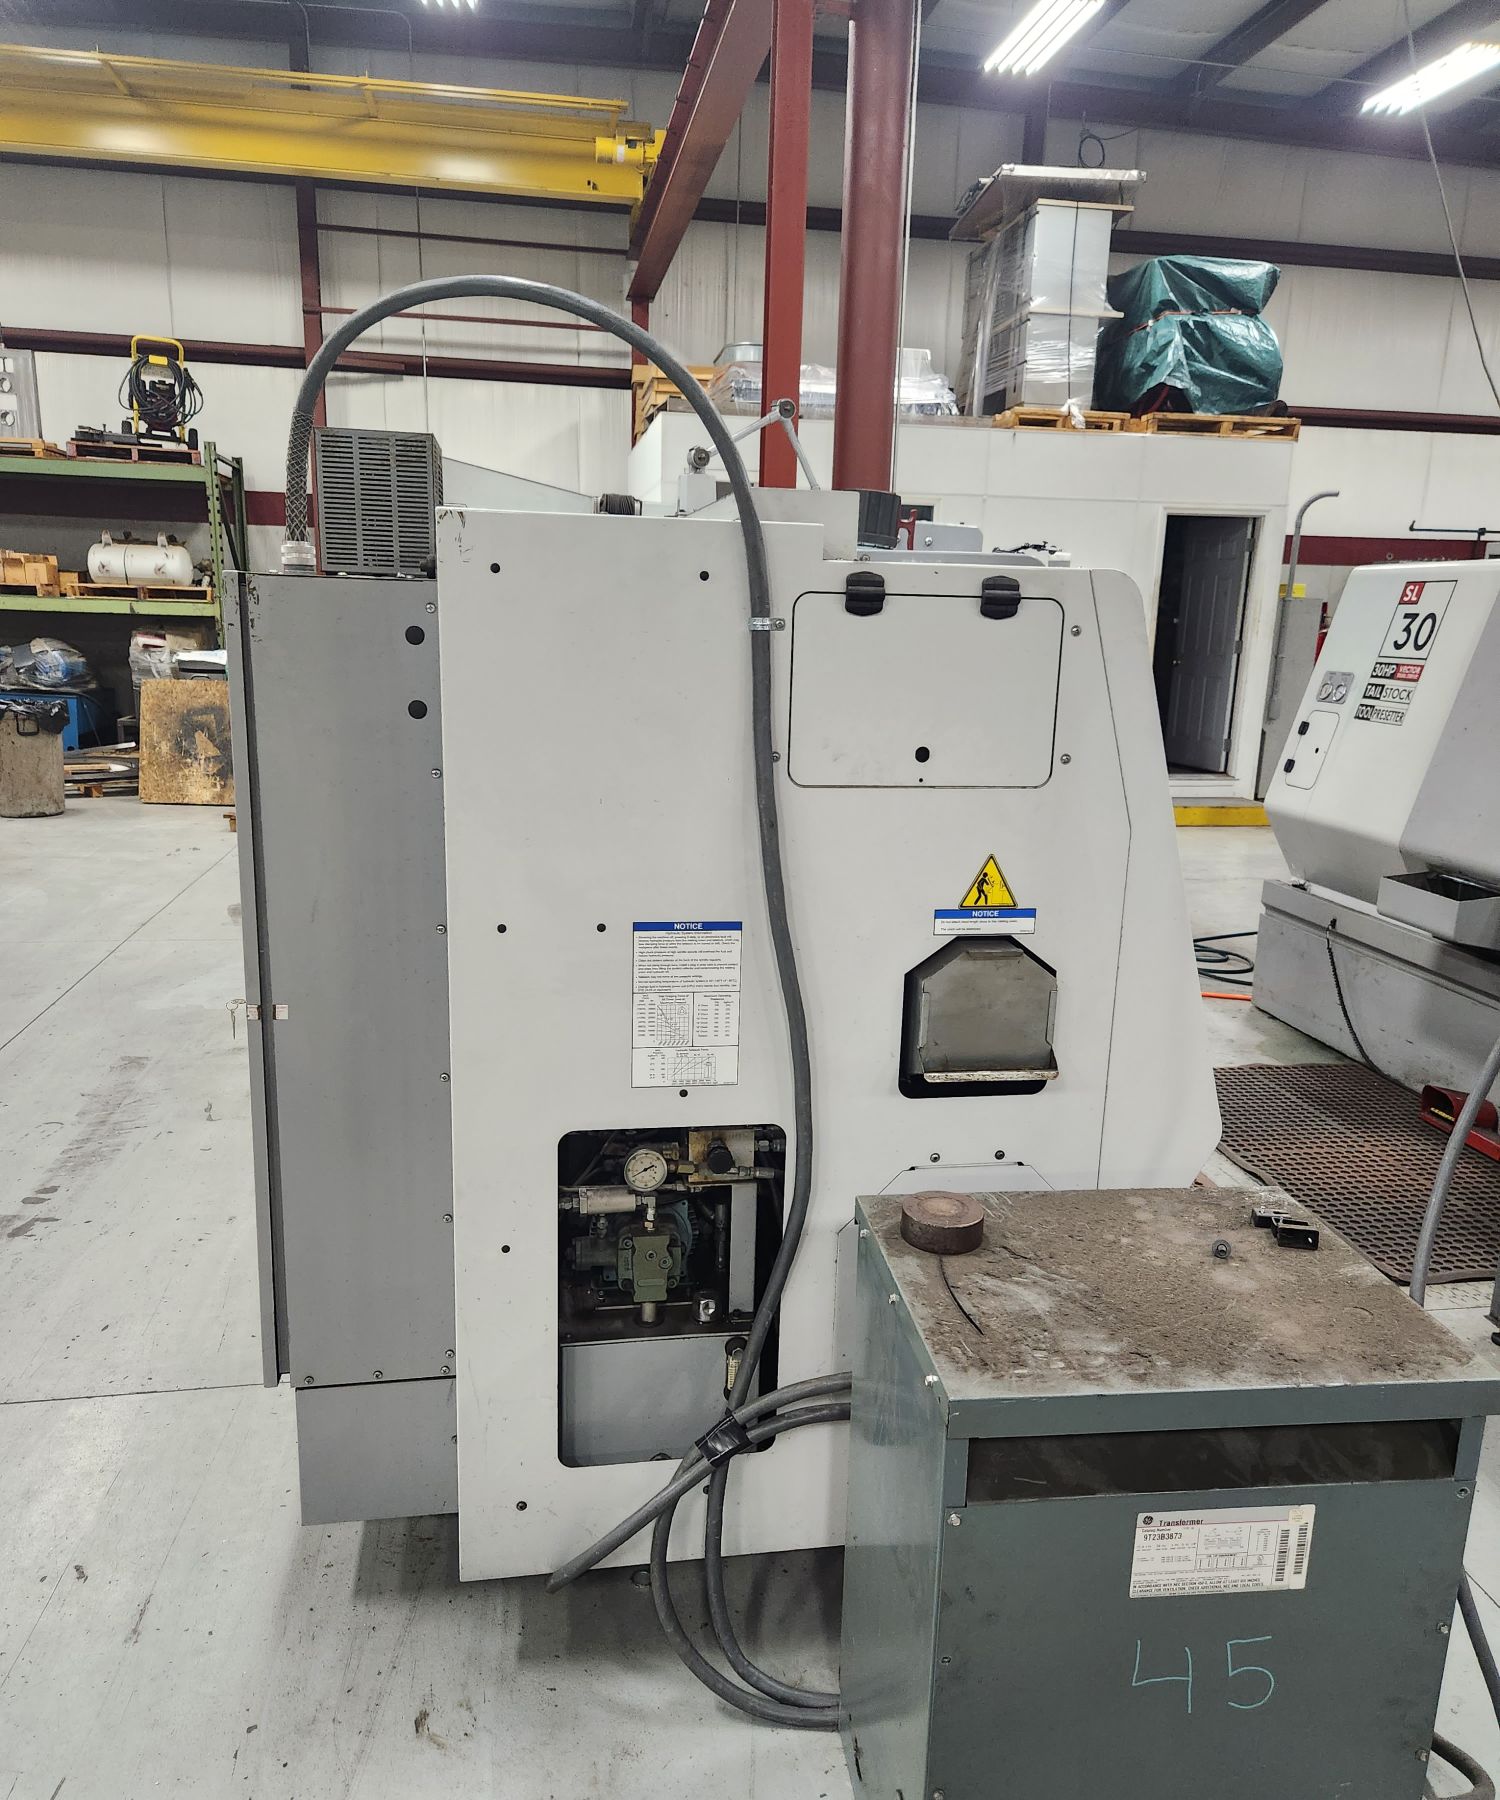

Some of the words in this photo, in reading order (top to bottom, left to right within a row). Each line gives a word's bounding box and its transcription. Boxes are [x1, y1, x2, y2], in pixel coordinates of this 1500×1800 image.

[1402, 585, 1420, 602] SL
[1393, 612, 1437, 651] 30
[1372, 663, 1397, 677] 30HP
[972, 910, 999, 918] NOTICE
[673, 922, 703, 930] NOTICE
[1159, 1518, 1204, 1527] Transformer
[1131, 1635, 1275, 1714] 45
